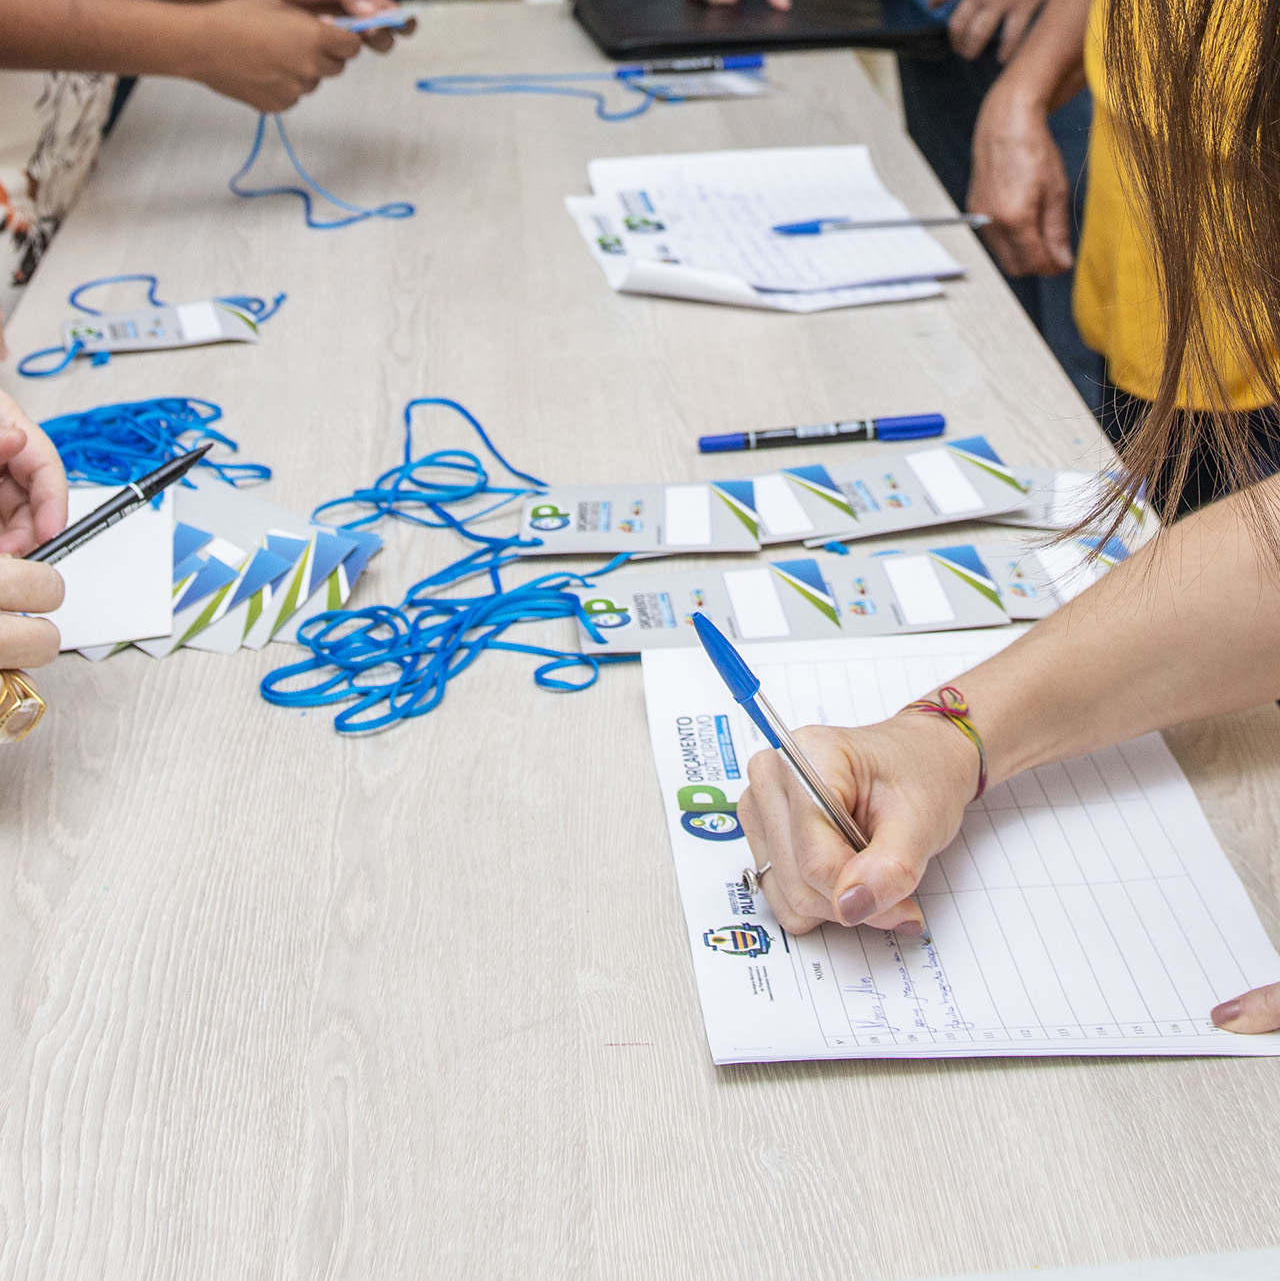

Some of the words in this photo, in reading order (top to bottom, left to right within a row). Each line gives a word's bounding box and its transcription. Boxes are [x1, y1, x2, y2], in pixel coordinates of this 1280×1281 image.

[676, 716, 705, 783] ORÇAMENTO
[696, 714, 724, 781] PARTICIPATIVO
[812, 961, 824, 980] NOME
[1057, 1028, 1070, 1036] 113
[1095, 1027, 1107, 1035] 114
[1132, 1025, 1144, 1034] 115
[1169, 1023, 1181, 1033] 116
[1020, 1029, 1032, 1037] 112
